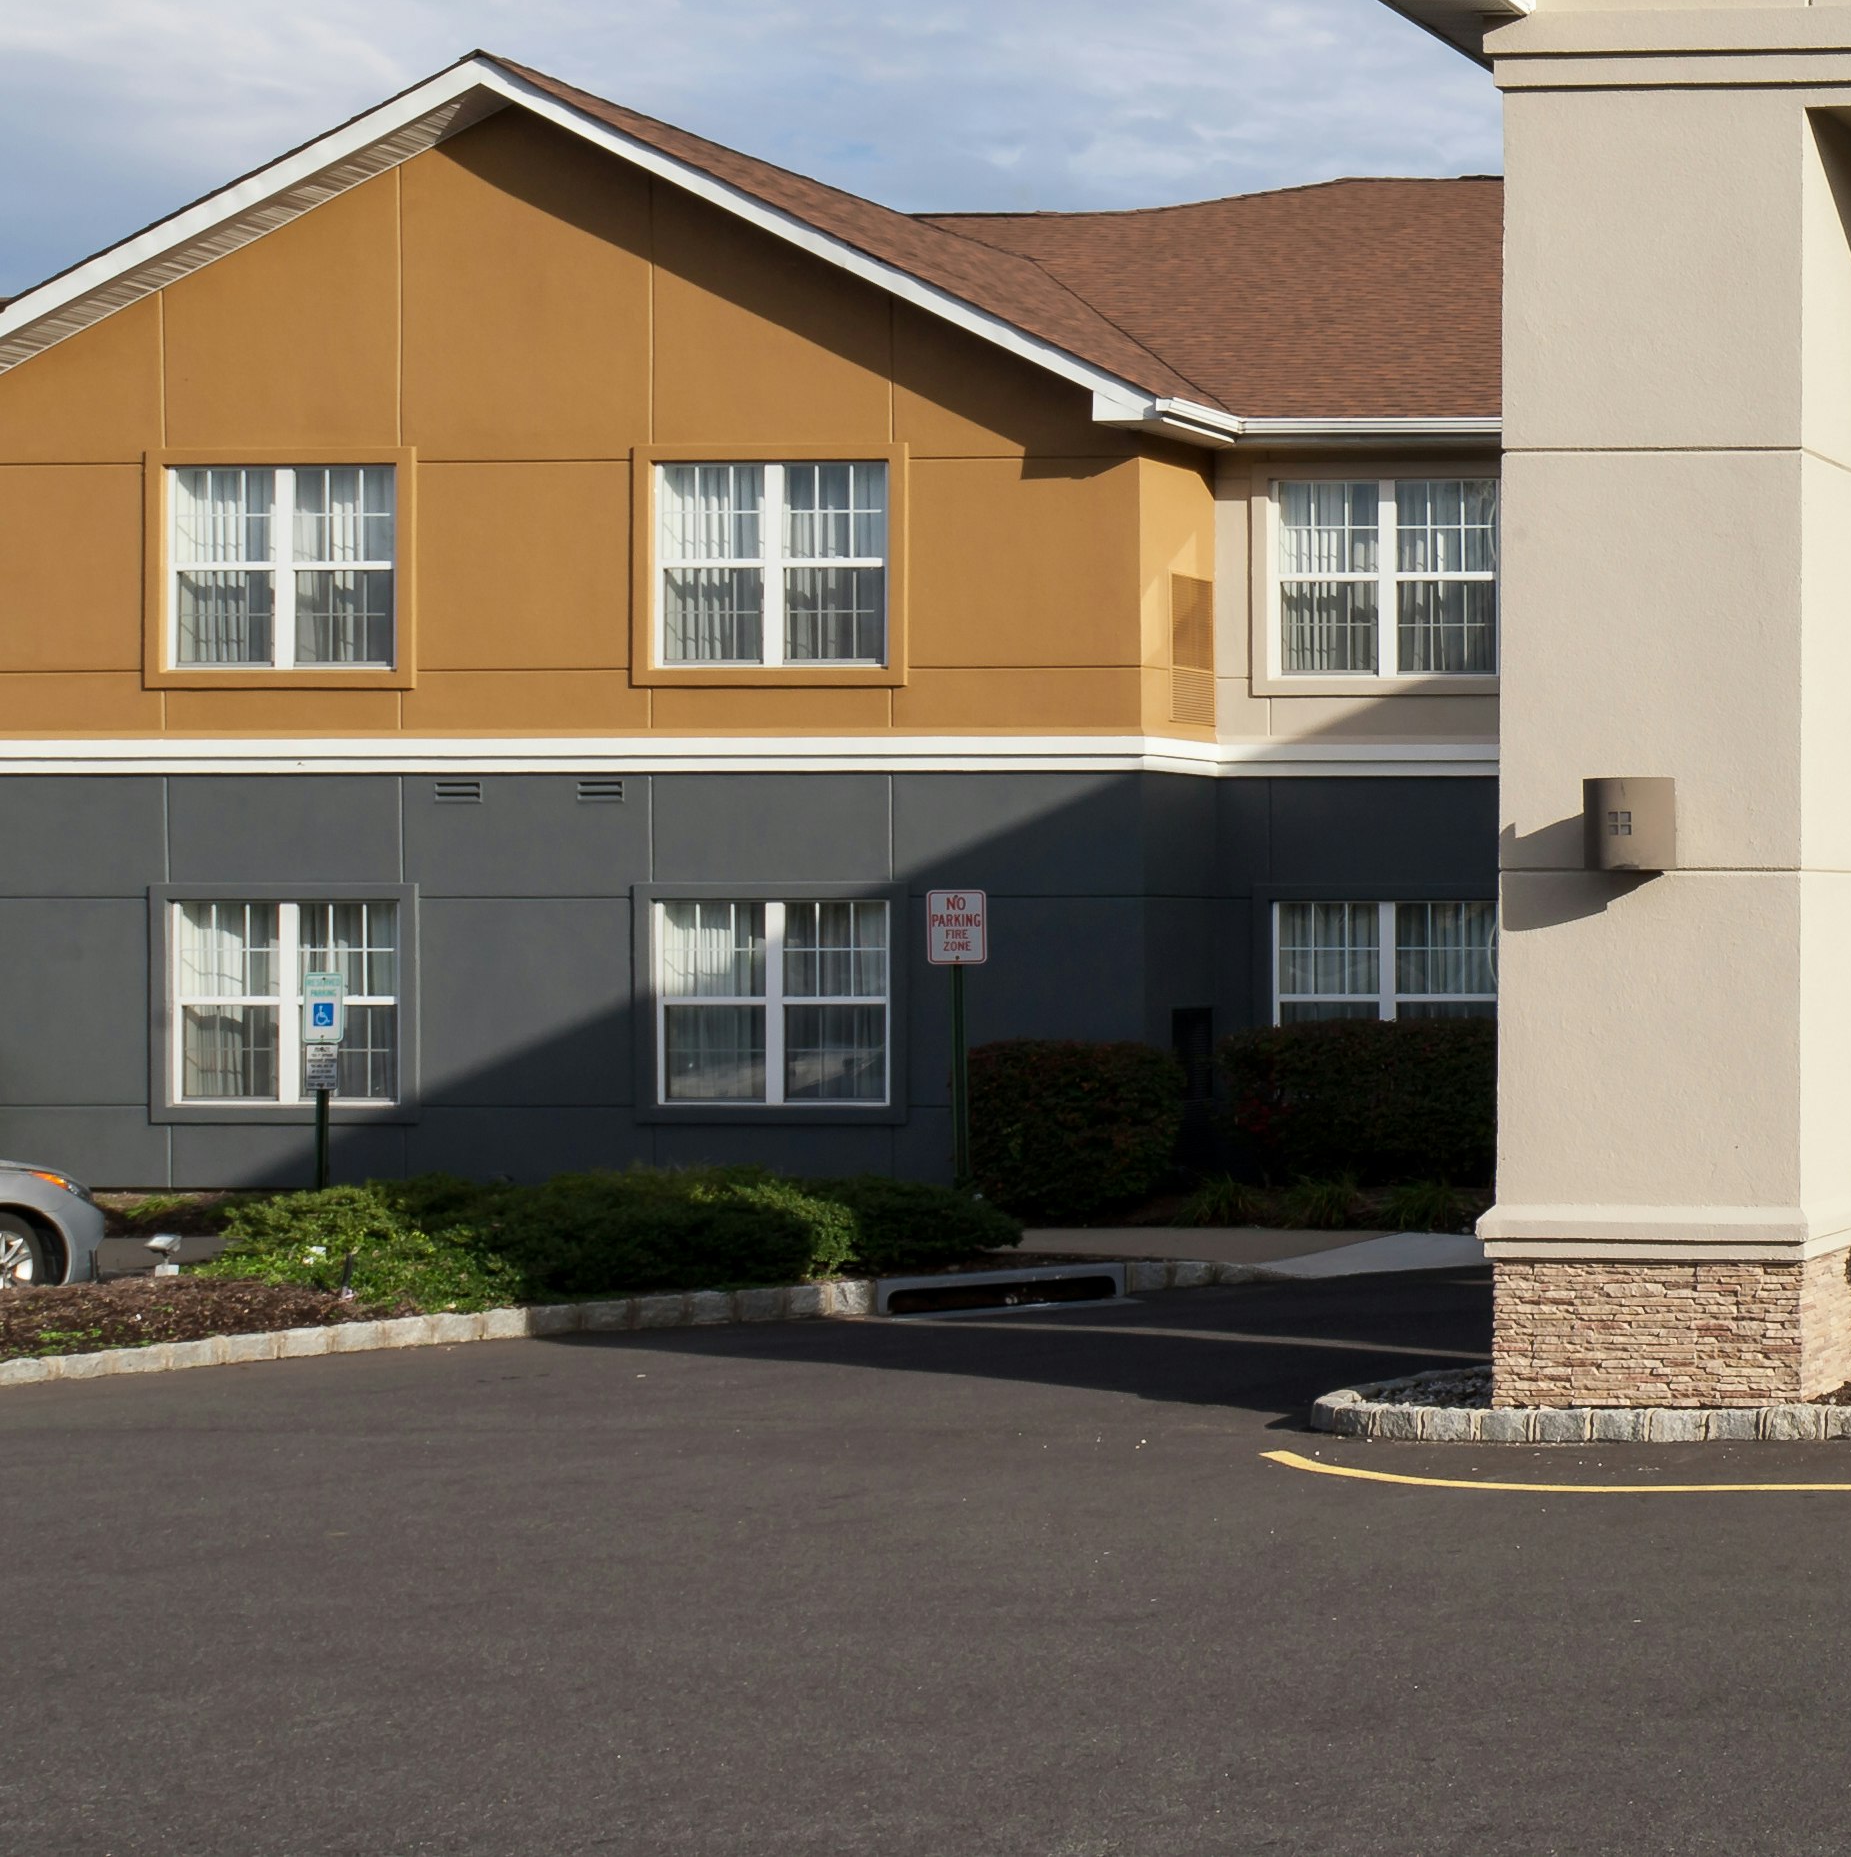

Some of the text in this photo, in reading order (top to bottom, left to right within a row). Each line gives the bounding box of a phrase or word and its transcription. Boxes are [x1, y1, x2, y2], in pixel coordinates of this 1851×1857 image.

[946, 896, 966, 911] NO
[931, 913, 982, 928] PARKING
[945, 929, 969, 940] FIRE
[943, 941, 972, 952] ZONE
